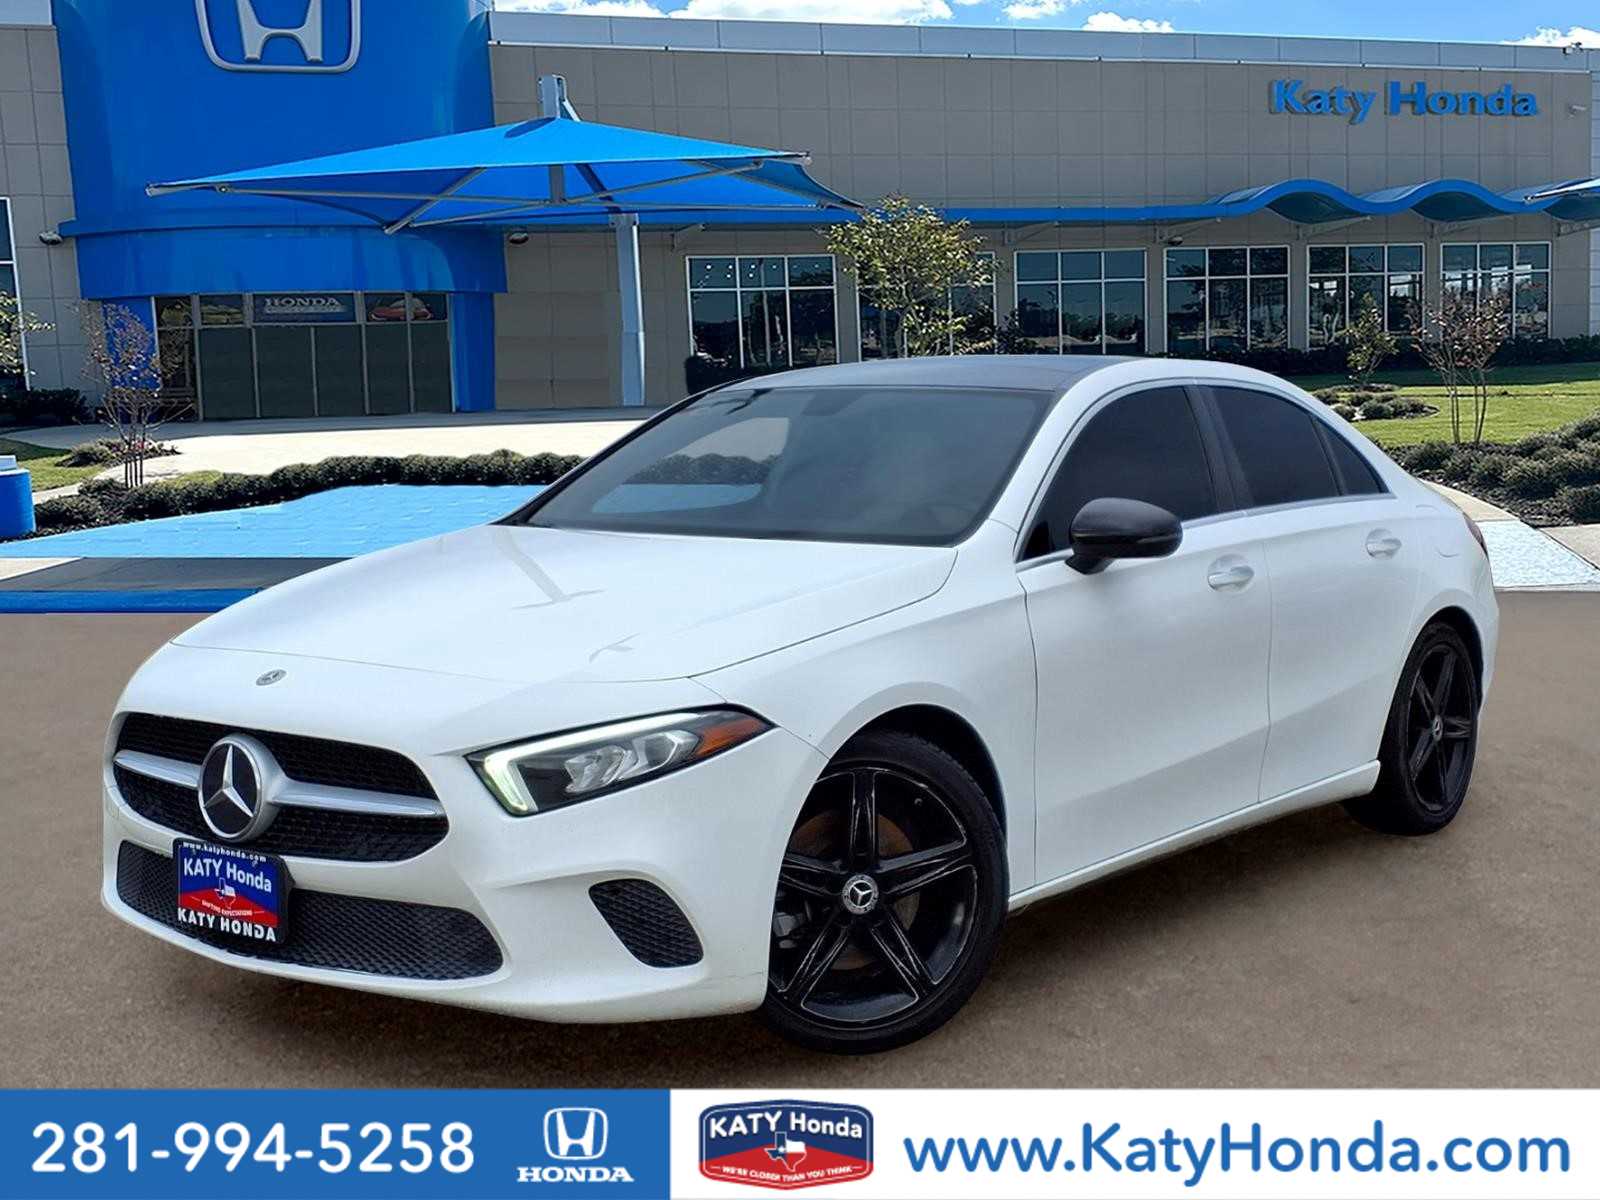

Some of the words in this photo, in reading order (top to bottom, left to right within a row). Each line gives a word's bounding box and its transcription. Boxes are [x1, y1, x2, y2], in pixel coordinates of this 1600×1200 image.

[1269, 79, 1377, 125] Katy
[1385, 80, 1538, 117] Honda
[264, 297, 342, 307] HONDA
[183, 858, 222, 877] KATY
[226, 861, 272, 893] Honda
[178, 907, 215, 928] KATY
[220, 918, 276, 941] HONDA
